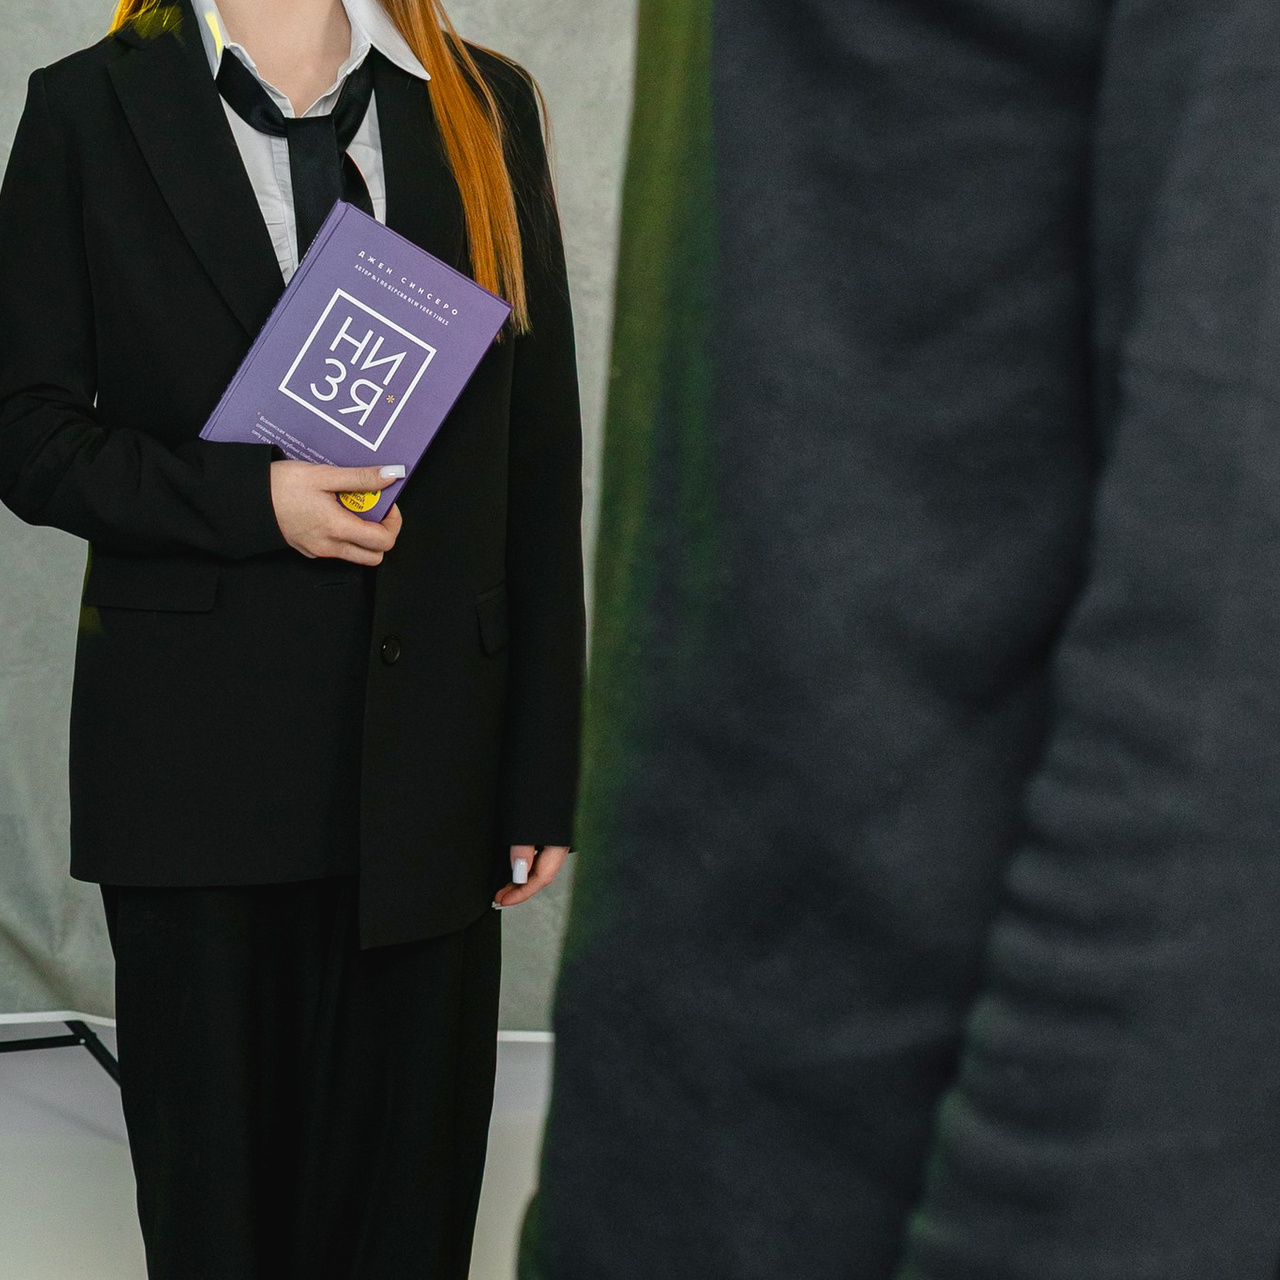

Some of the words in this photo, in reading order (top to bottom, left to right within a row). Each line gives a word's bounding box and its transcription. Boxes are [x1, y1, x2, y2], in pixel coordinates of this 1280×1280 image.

[358, 250, 393, 275] ДЖЕН
[401, 277, 458, 316] СИНСЕРО
[329, 316, 407, 386] НИ
